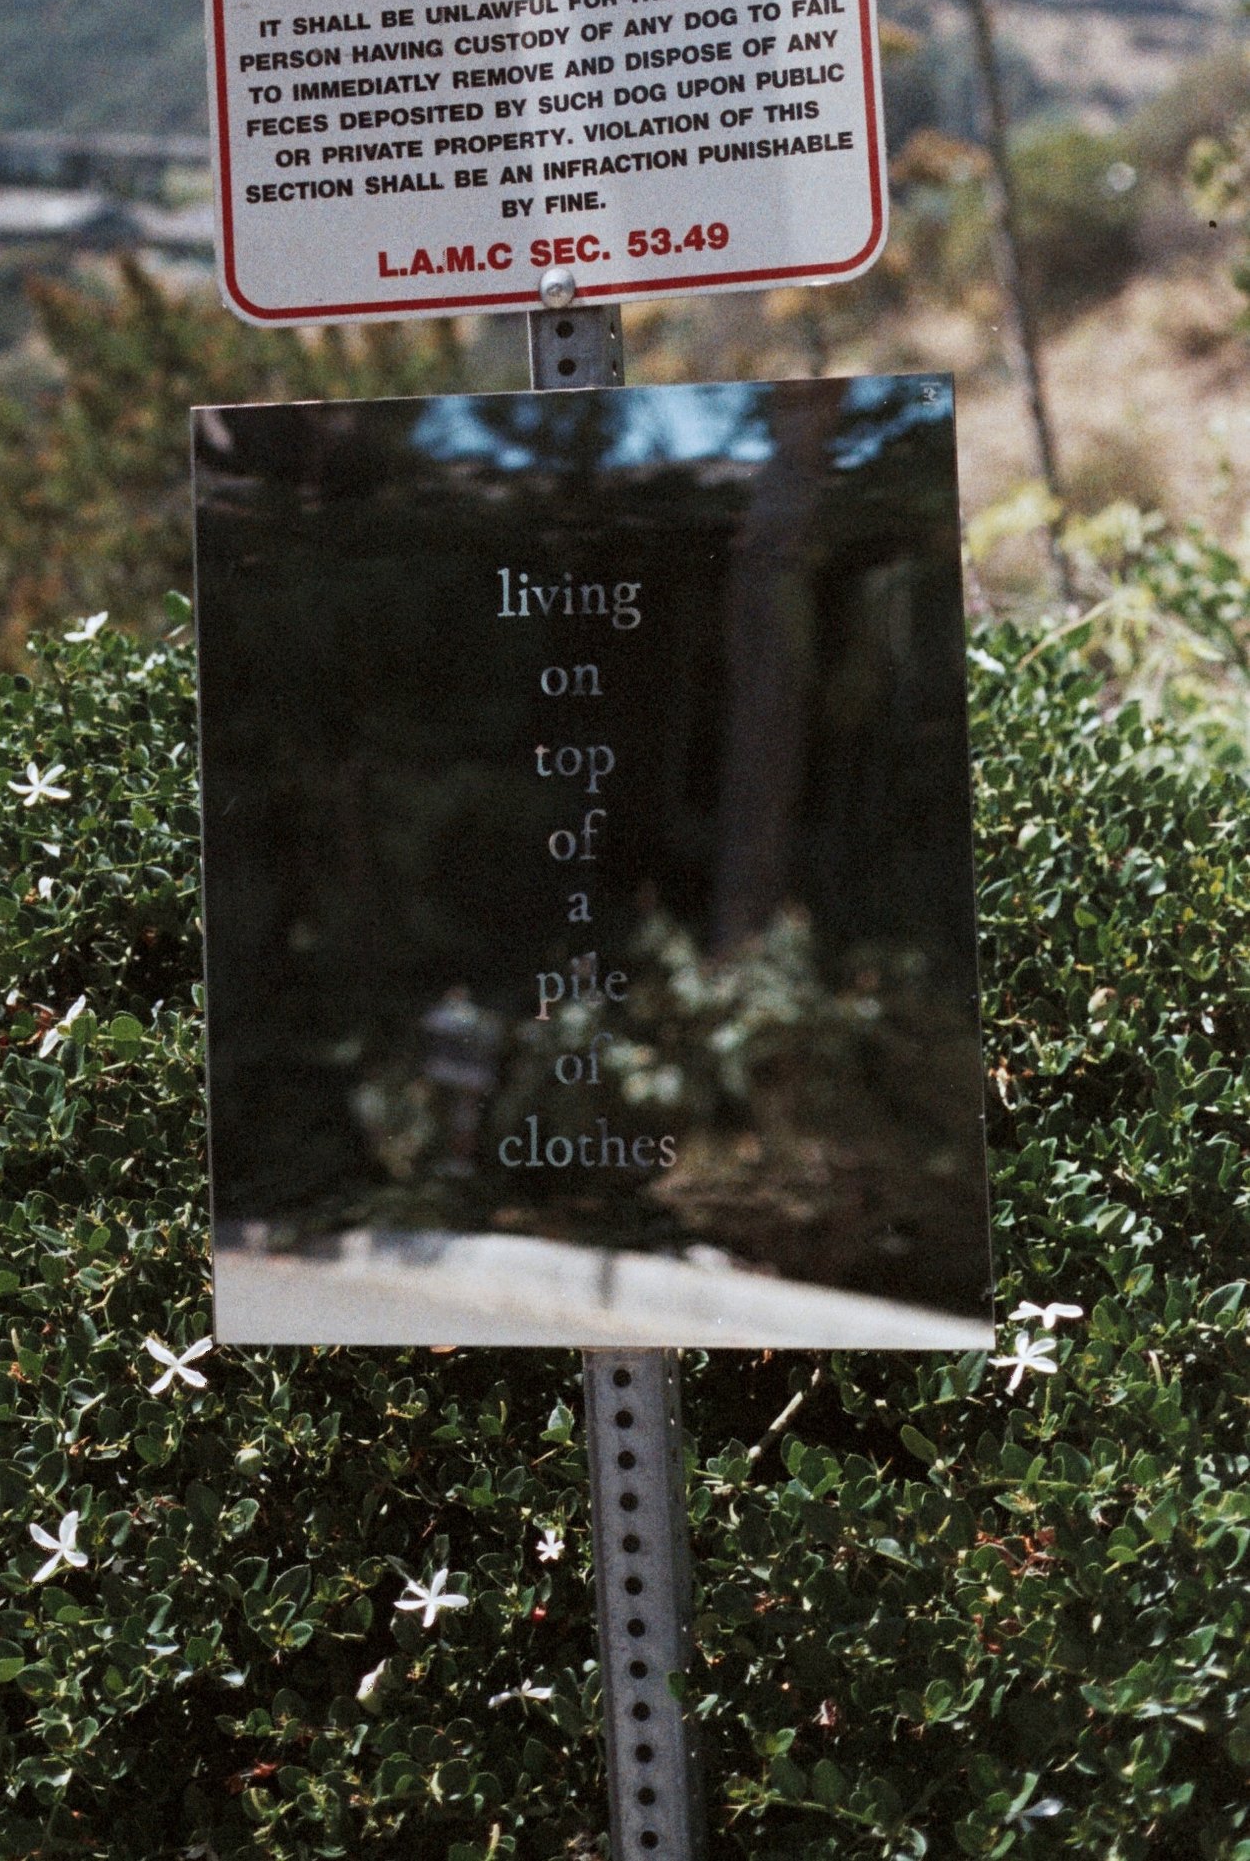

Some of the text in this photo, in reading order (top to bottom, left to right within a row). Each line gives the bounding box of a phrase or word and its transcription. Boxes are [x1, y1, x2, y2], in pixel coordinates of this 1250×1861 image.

[239, 46, 342, 74] PERSON
[351, 38, 445, 65] HAVING
[453, 26, 570, 57] CUSTODY
[580, 21, 614, 43] OF
[623, 14, 674, 38] ANY
[684, 6, 738, 31] DOG
[747, 2, 781, 24] TO
[258, 18, 283, 39] IT
[292, 12, 372, 36] SHALL
[380, 8, 415, 29] BE
[247, 29, 838, 105] TO IMMEDIATLY REMOVE AND DISPOSE OF ANY
[245, 63, 844, 139] FECES DEPOSITED BY SUCH DOG UPON PUBLIC
[274, 100, 820, 169] OR PRIVATE PROPERTY. VIOLATION OF THIS
[245, 131, 854, 205] SECTION SHALL BE AN INFRACTION PUNISHABLE
[501, 190, 607, 219] BY FINE.
[377, 221, 730, 279] L.A.M.C SEC. 53.49
[497, 567, 642, 630] living
[540, 663, 603, 697] on
[536, 744, 615, 793] top
[549, 810, 607, 860] of
[567, 892, 592, 923] a
[537, 952, 629, 1021] pile
[555, 1033, 613, 1085] of
[497, 1116, 678, 1169] clothes
